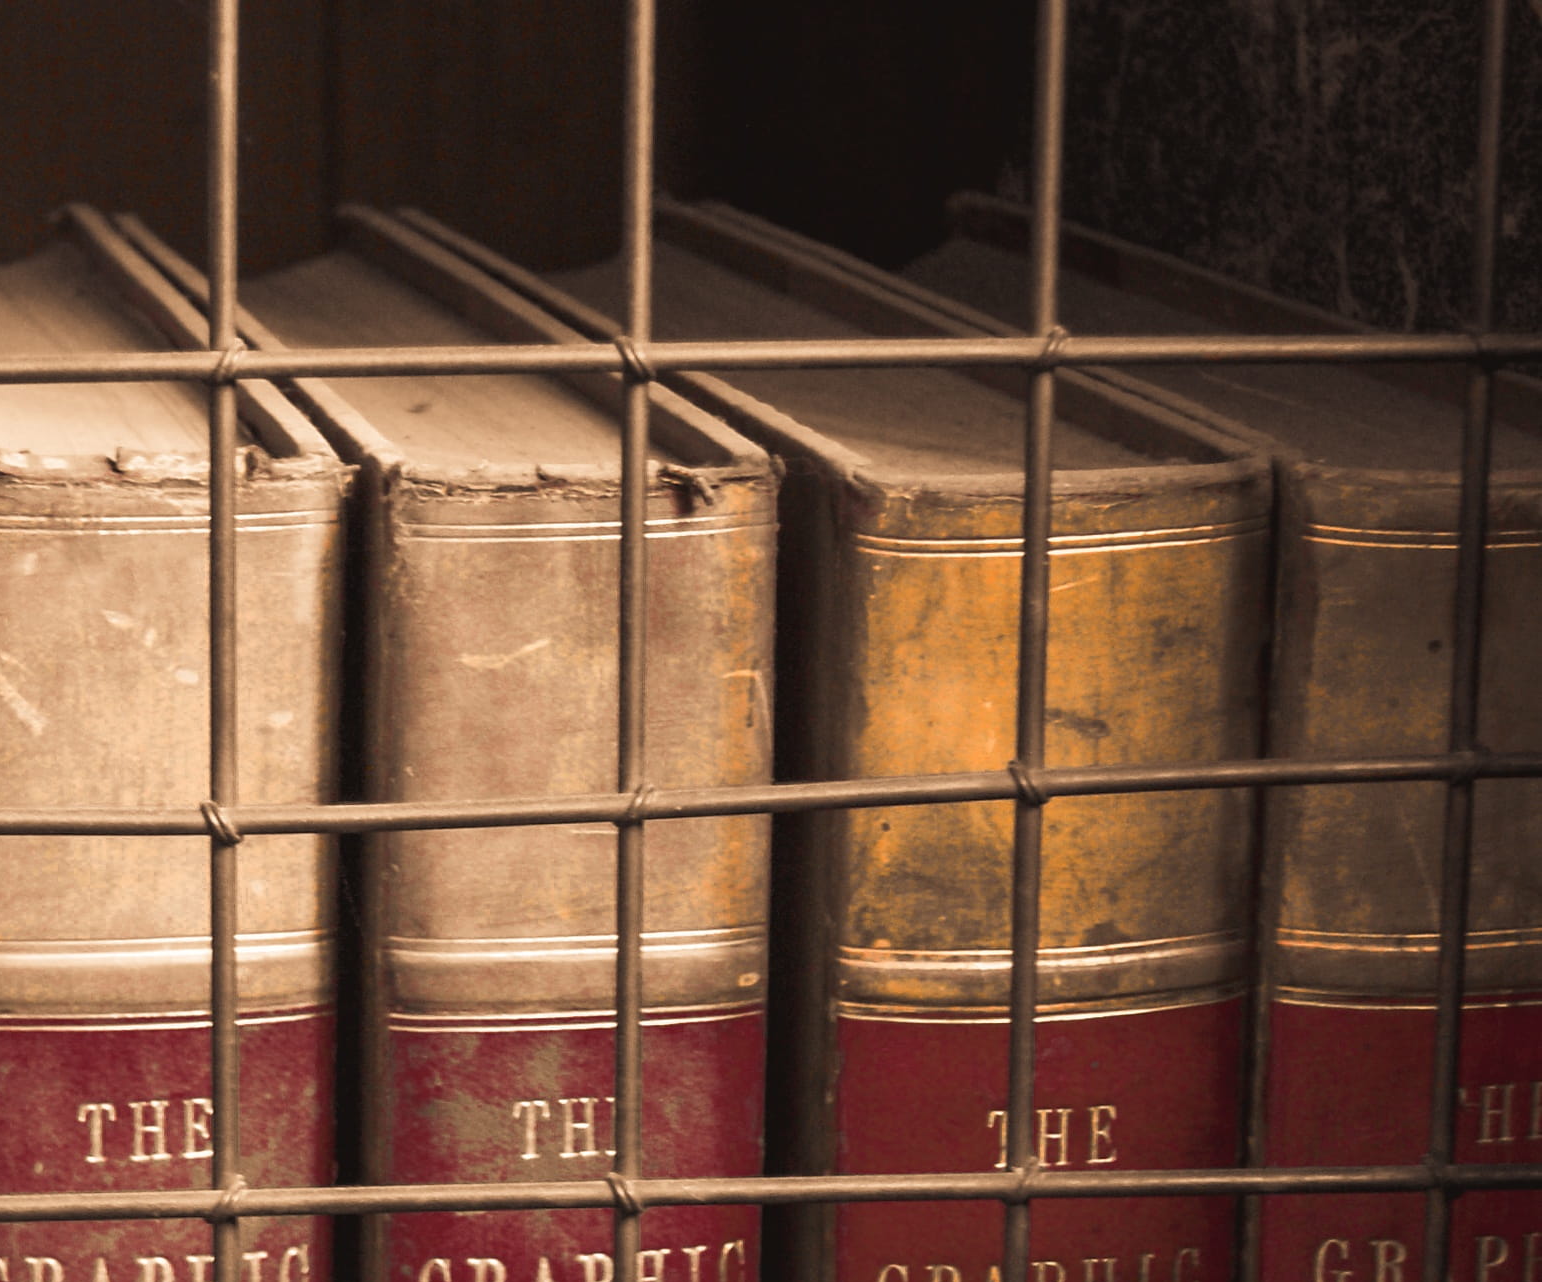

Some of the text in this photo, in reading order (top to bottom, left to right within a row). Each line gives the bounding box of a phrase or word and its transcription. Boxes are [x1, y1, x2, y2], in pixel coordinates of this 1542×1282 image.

[77, 1098, 214, 1164] THE
[512, 1096, 616, 1160] TH
[987, 1105, 1117, 1169] THE
